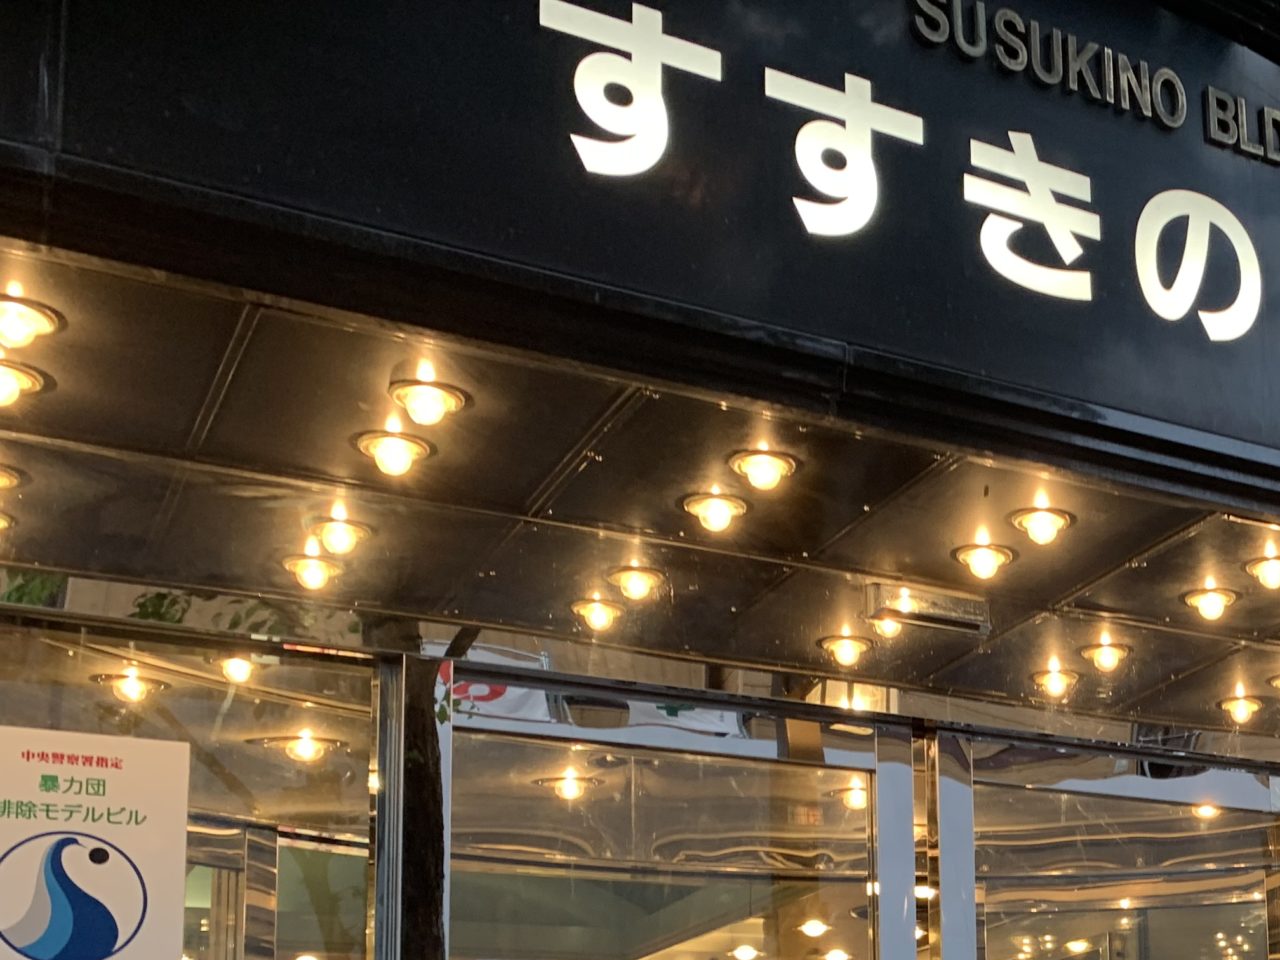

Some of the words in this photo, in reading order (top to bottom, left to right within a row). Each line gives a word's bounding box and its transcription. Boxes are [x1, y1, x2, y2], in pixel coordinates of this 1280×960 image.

[912, 0, 1188, 129] SUSUKINO
[21, 750, 124, 770] 中央警察署指定
[39, 775, 106, 797] 暴力団
[0, 800, 147, 826] 排除モデルビル
